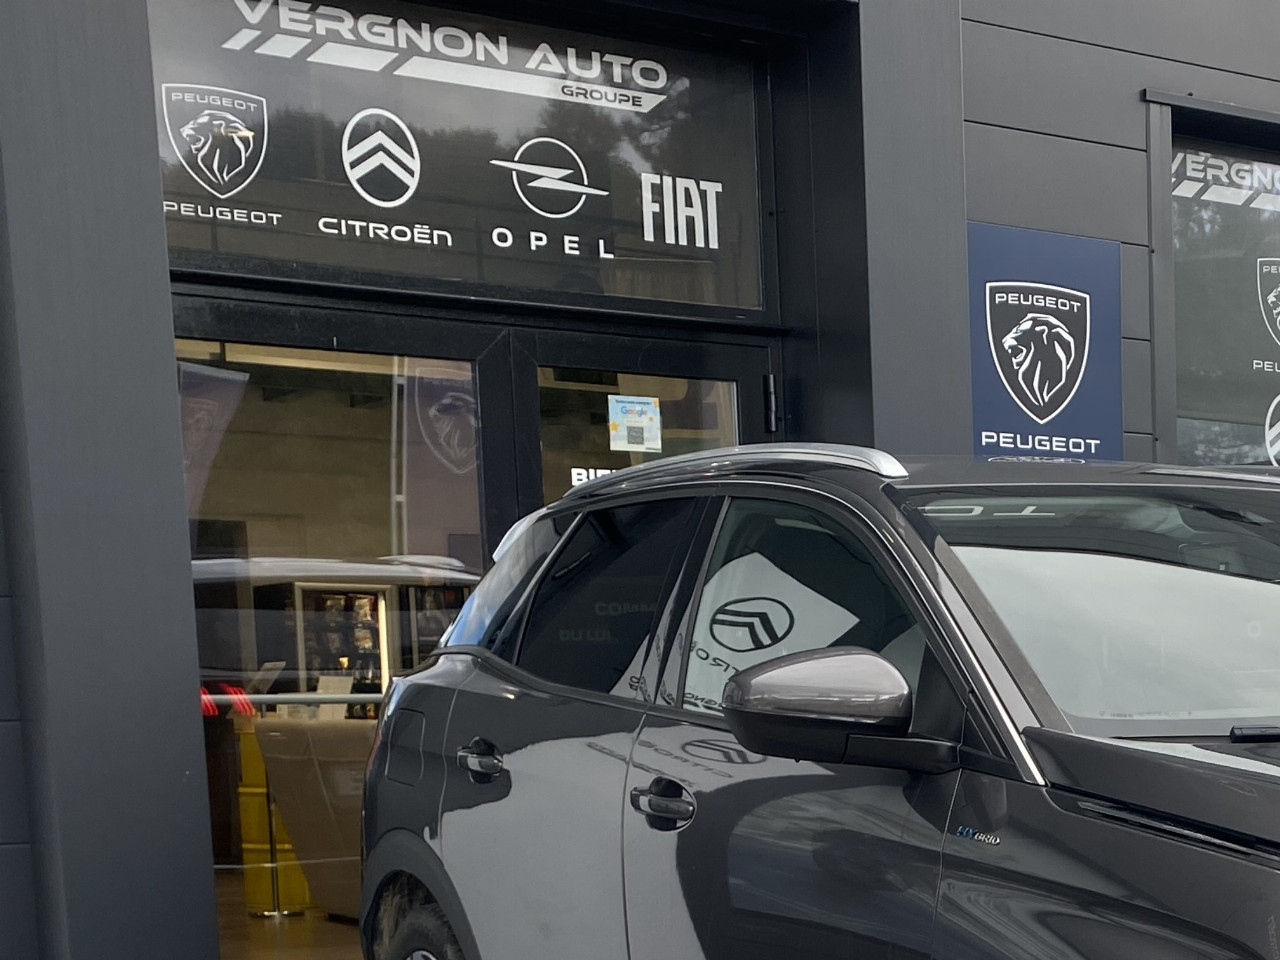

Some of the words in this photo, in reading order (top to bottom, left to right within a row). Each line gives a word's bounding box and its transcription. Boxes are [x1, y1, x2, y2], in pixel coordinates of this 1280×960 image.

[234, 0, 509, 65] VERGNON
[525, 42, 668, 89] AUTO
[171, 91, 258, 112] PEUGEOT
[561, 84, 643, 107] GROUPE
[162, 200, 283, 226] PEUGEOT
[641, 172, 723, 250] FIAT
[492, 226, 615, 260] OPEL
[995, 292, 1082, 313] PEUGEOT
[981, 431, 1101, 454] PEUGEOT
